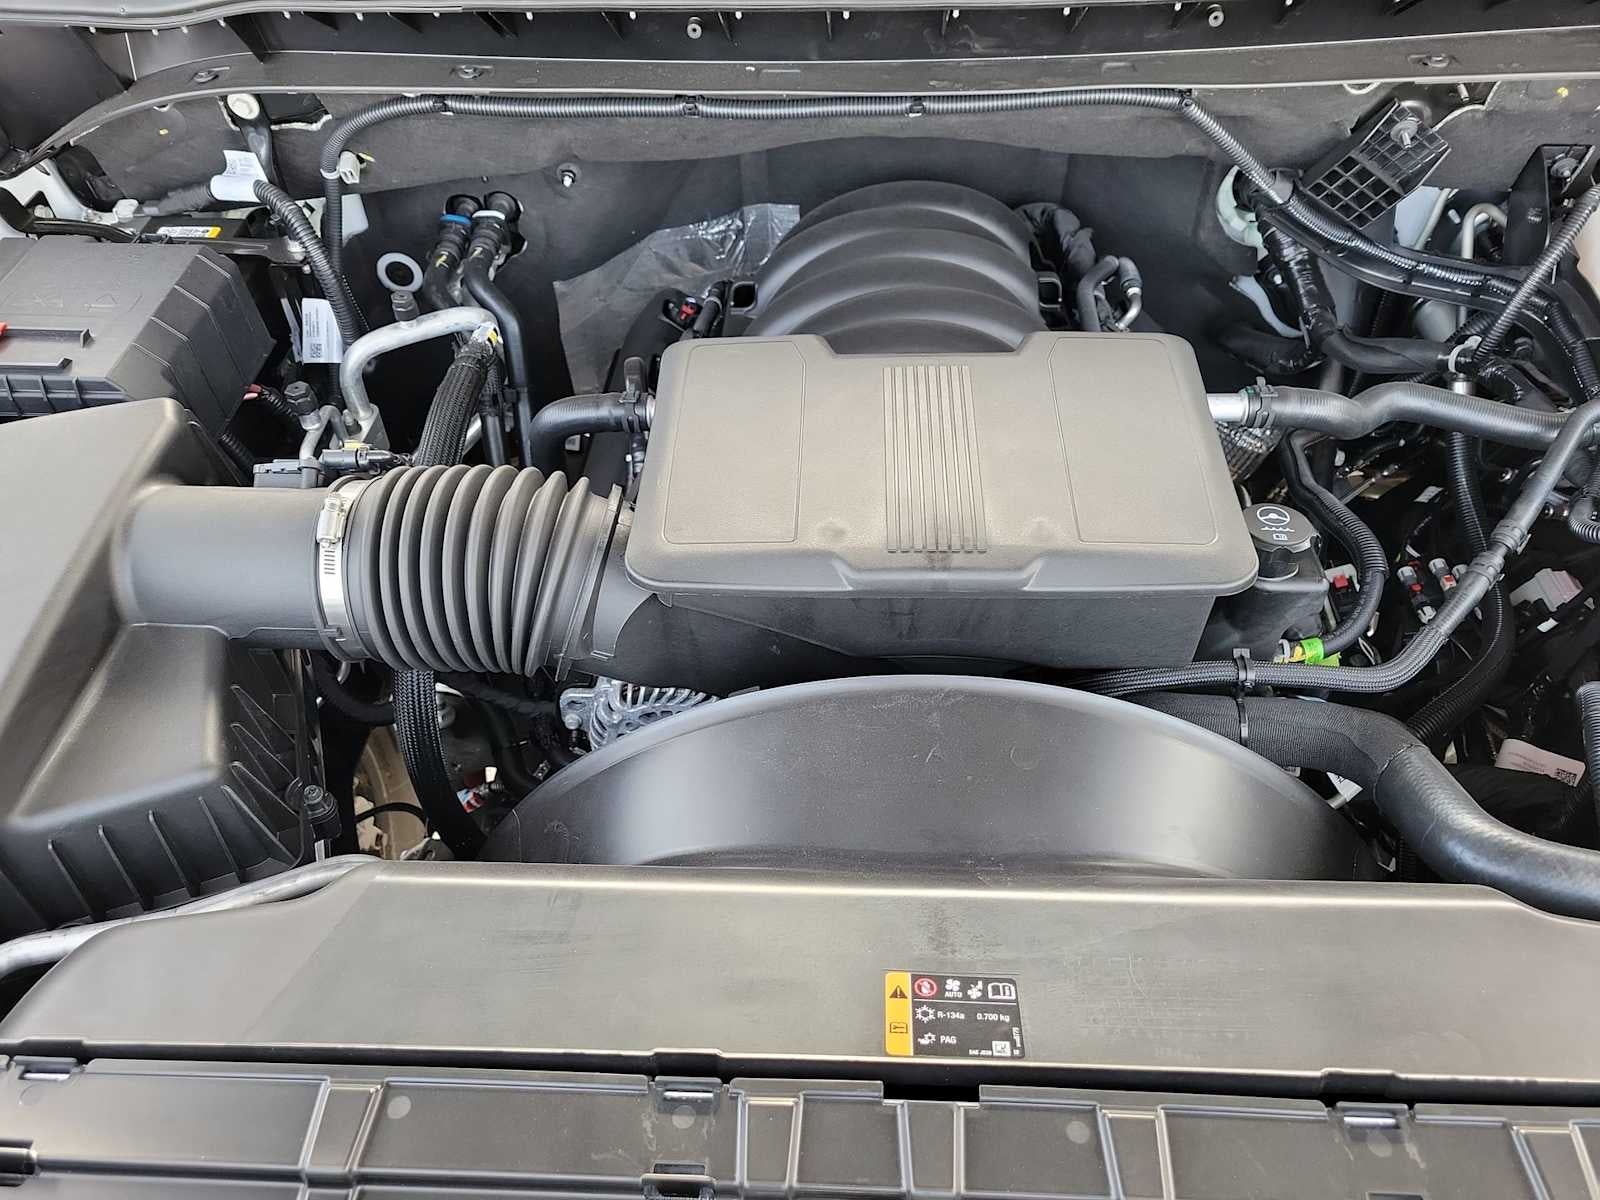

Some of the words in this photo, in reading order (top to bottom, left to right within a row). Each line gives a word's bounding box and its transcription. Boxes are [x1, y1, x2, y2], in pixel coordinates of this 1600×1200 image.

[937, 1011, 965, 1020] R-134a
[976, 1013, 998, 1021] 0.700
[999, 1013, 1010, 1023] kg
[939, 1035, 957, 1044] PAG
